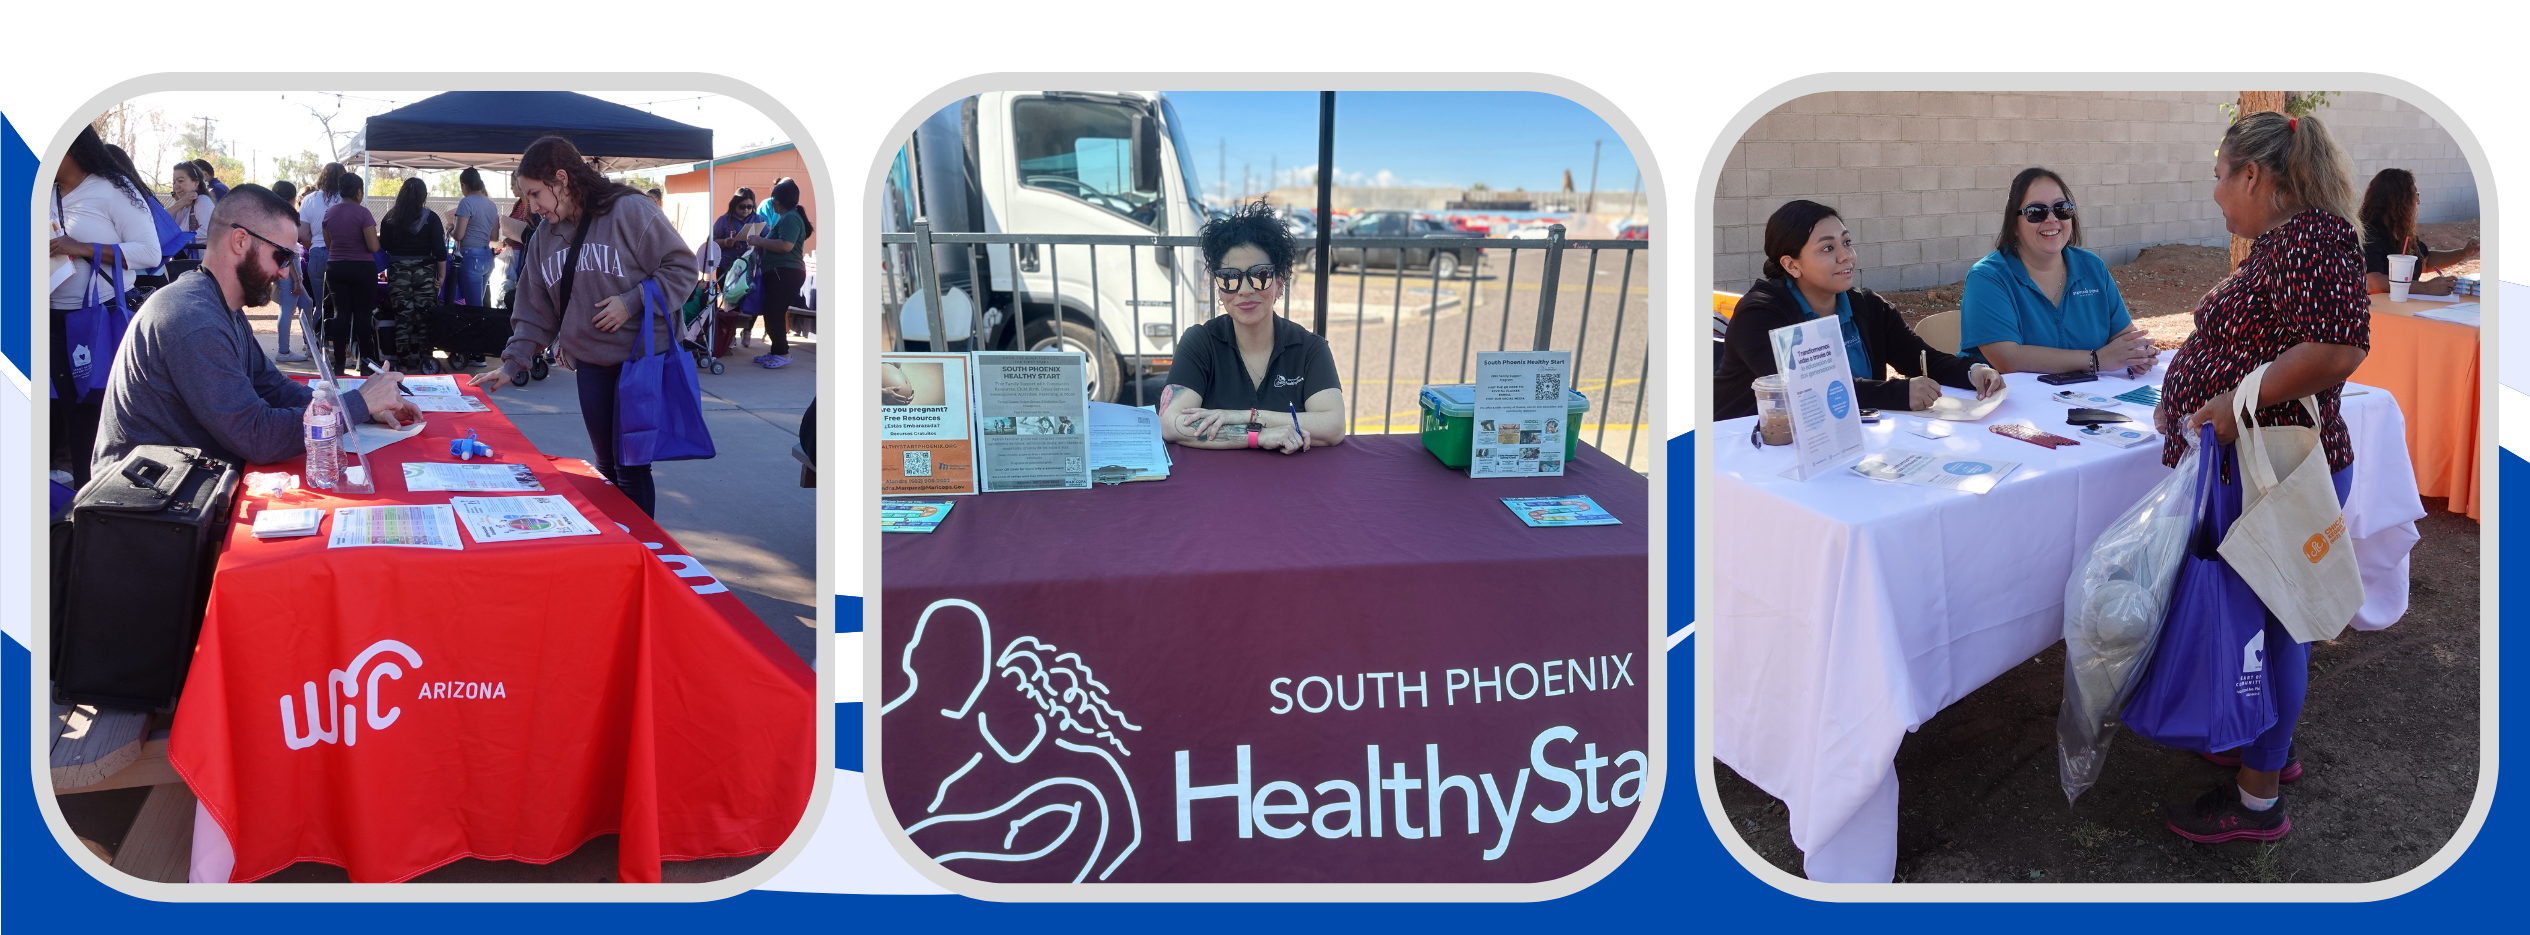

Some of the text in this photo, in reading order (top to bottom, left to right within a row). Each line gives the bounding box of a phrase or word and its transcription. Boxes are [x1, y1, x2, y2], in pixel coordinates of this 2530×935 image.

[1797, 343, 1830, 357] Transformamos
[1798, 356, 1809, 364] vidas
[418, 681, 506, 699] ARIZONA
[1270, 653, 1634, 714] SOUTH PHOENIX
[1175, 726, 1648, 860] HealthySta
